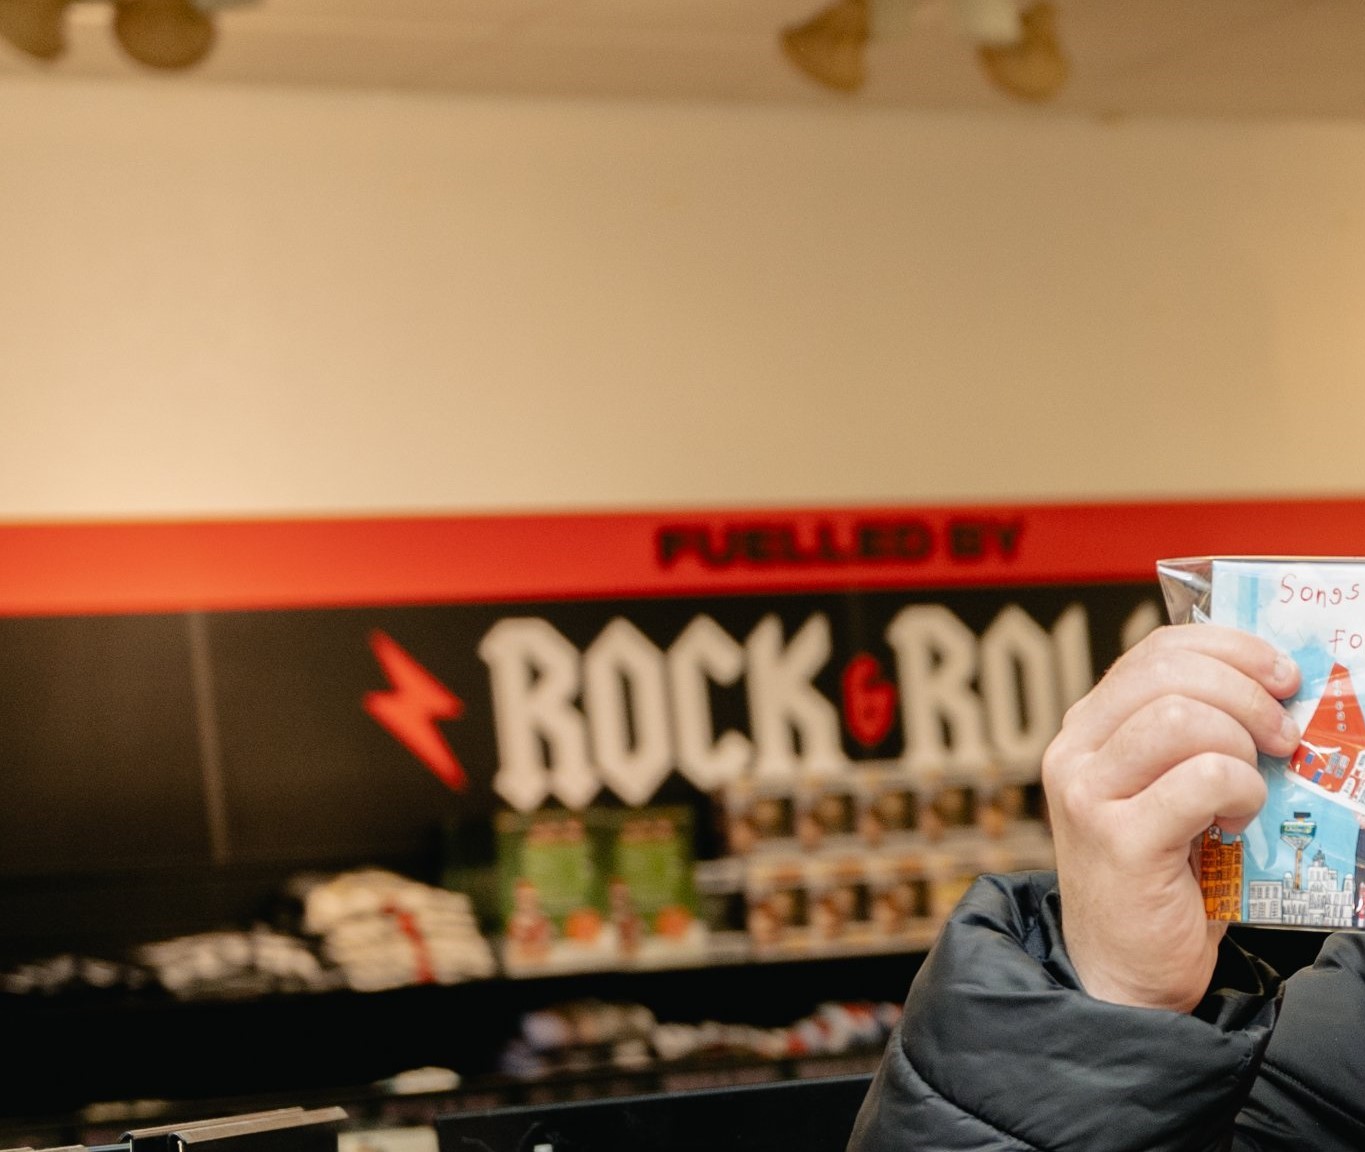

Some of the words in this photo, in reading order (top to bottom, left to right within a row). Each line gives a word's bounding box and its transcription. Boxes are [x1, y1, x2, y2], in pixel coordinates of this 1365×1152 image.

[657, 520, 934, 570] FUELLED
[947, 518, 1026, 566] BY
[1279, 573, 1360, 608] Songs
[479, 612, 852, 811] ROCK
[886, 601, 1161, 780] RO
